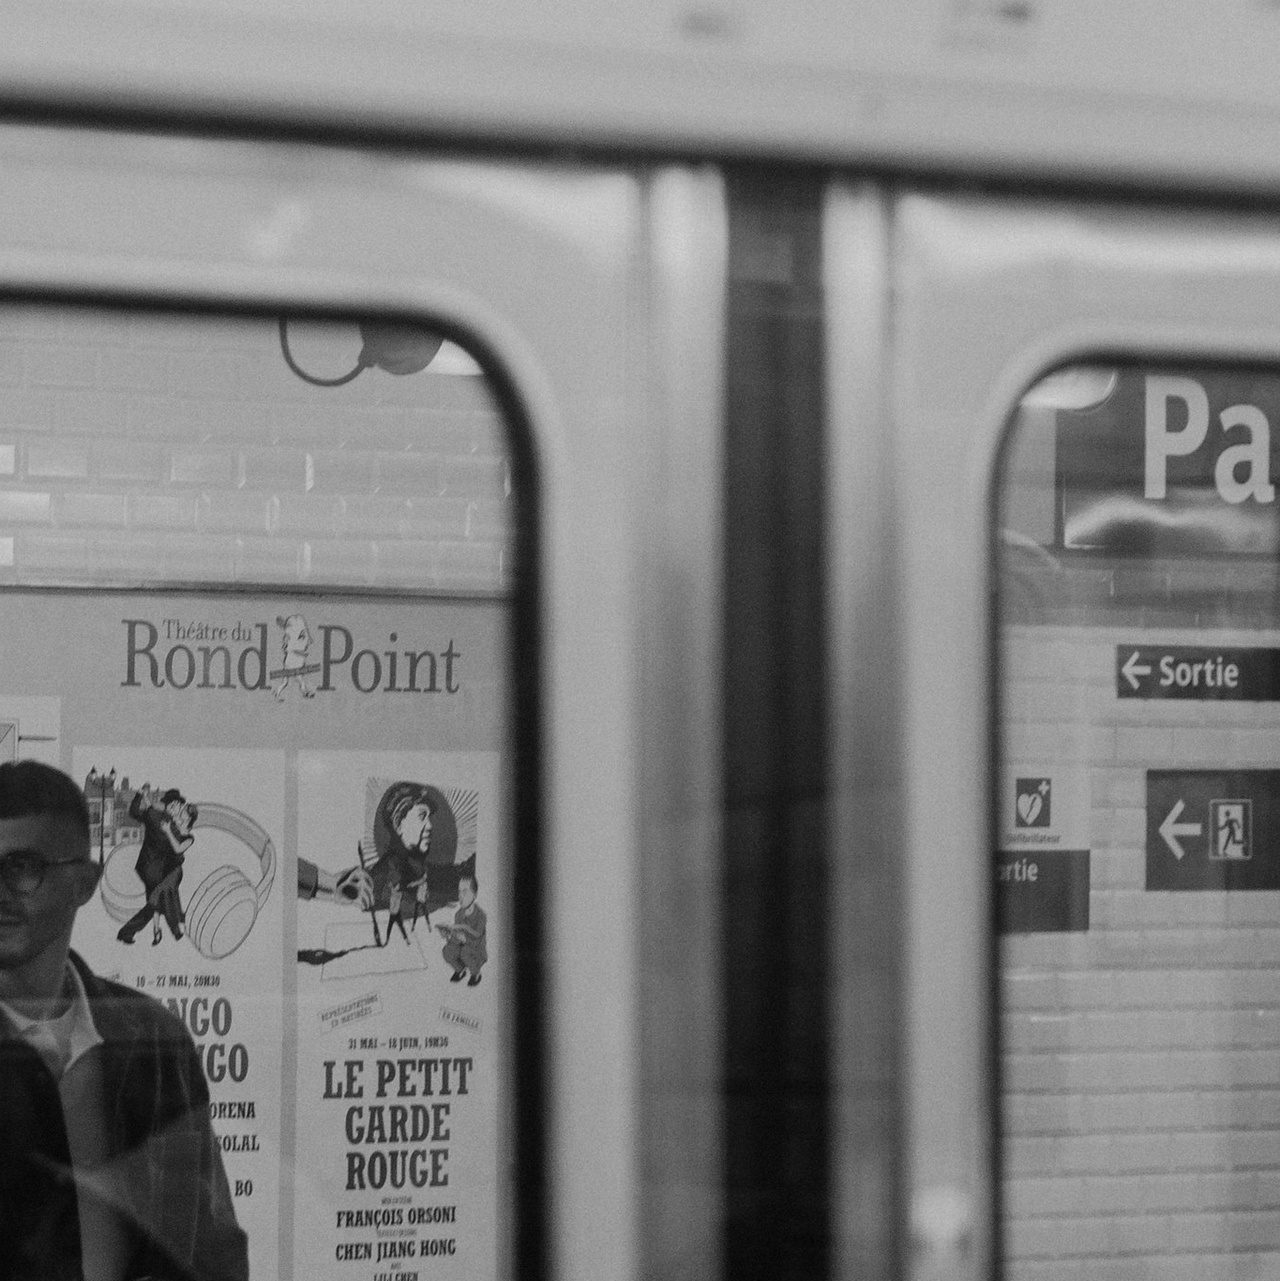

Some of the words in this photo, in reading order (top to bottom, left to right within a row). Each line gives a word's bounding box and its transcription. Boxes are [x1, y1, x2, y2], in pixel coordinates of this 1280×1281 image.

[1144, 375, 1275, 504] Pa
[162, 619, 228, 641] Théâtre
[231, 620, 252, 641] du
[120, 620, 271, 692] Rond
[317, 624, 461, 694] Point
[1159, 655, 1239, 688] Sortie
[1001, 858, 1039, 882] rtie
[160, 997, 232, 1037] NGO
[360, 1038, 378, 1050] MAI
[323, 1060, 364, 1099] LE
[376, 1057, 473, 1098] PETIT
[209, 1101, 256, 1119] ORENA
[345, 1103, 451, 1145] GARDE
[345, 1148, 449, 1191] ROUGE
[336, 1208, 404, 1230] FRANÇOIS
[407, 1205, 457, 1225] ORSONI
[335, 1243, 372, 1261] CHEN
[376, 1240, 416, 1263] JIANG
[420, 1238, 457, 1257] HONG
